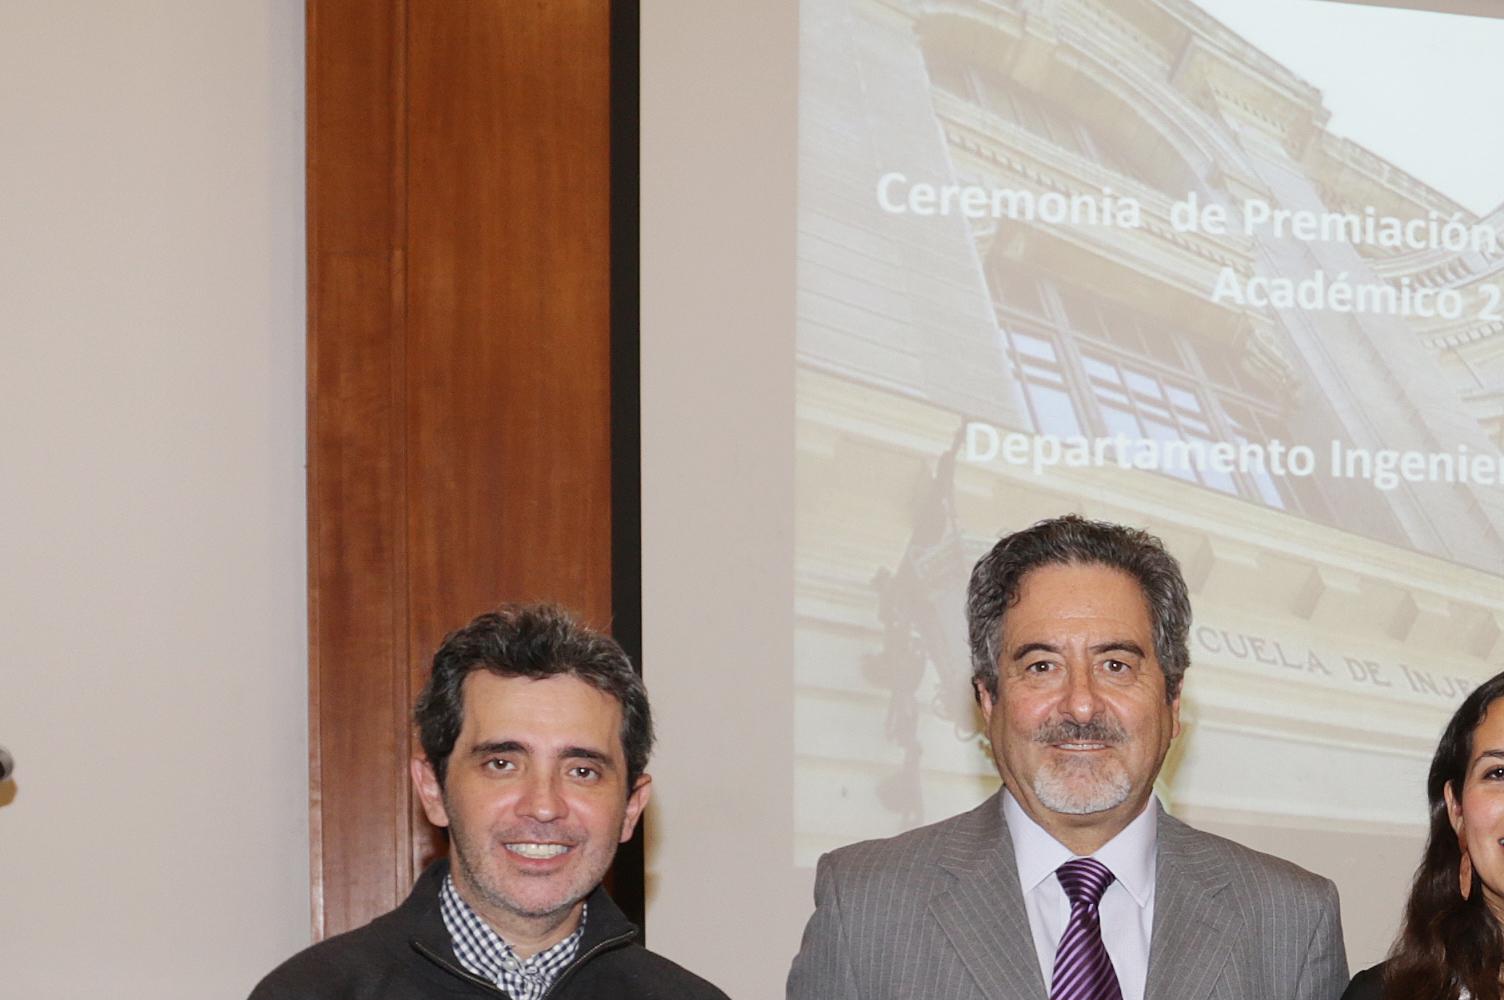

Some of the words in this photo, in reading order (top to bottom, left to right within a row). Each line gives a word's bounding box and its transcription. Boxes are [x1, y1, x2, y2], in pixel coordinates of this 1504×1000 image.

[877, 172, 1141, 228] Ceremonia
[1170, 192, 1227, 236] de
[1245, 199, 1495, 254] Premiación
[1210, 268, 1462, 319] Académico
[965, 424, 1314, 476] Departamento
[1196, 626, 1332, 675] CUELA
[1343, 657, 1392, 687] DE
[1398, 663, 1480, 698] INJE
